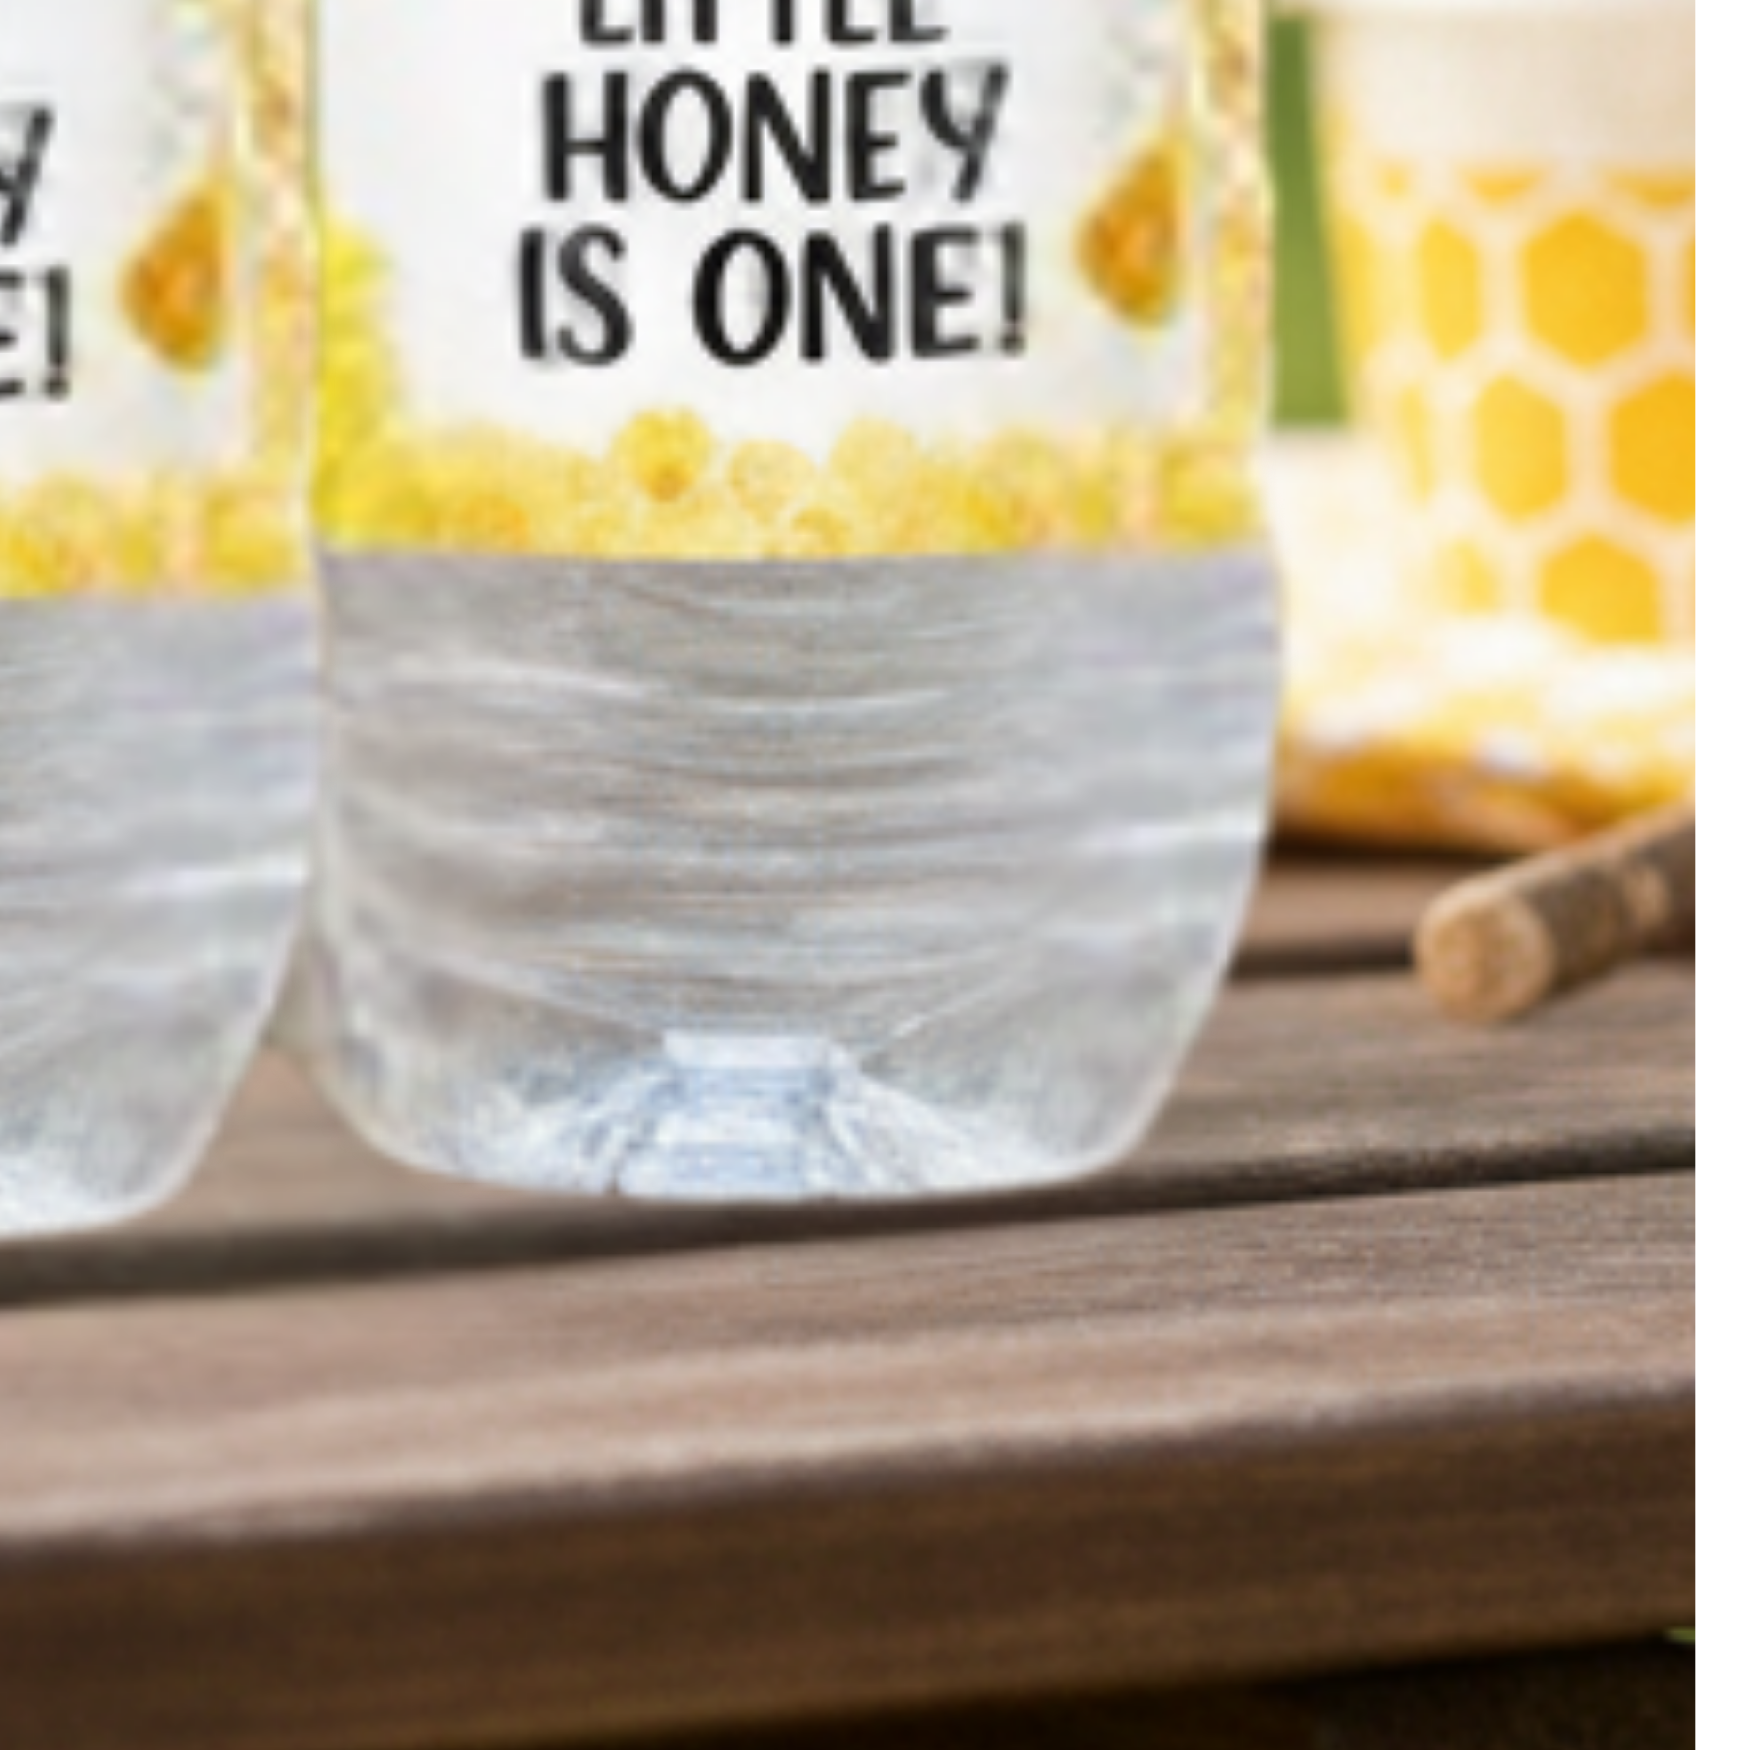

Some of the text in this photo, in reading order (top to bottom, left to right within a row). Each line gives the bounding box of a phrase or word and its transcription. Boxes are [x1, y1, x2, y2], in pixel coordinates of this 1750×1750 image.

[542, 64, 1009, 204] HONEY
[517, 224, 1026, 367] IS ONE!
